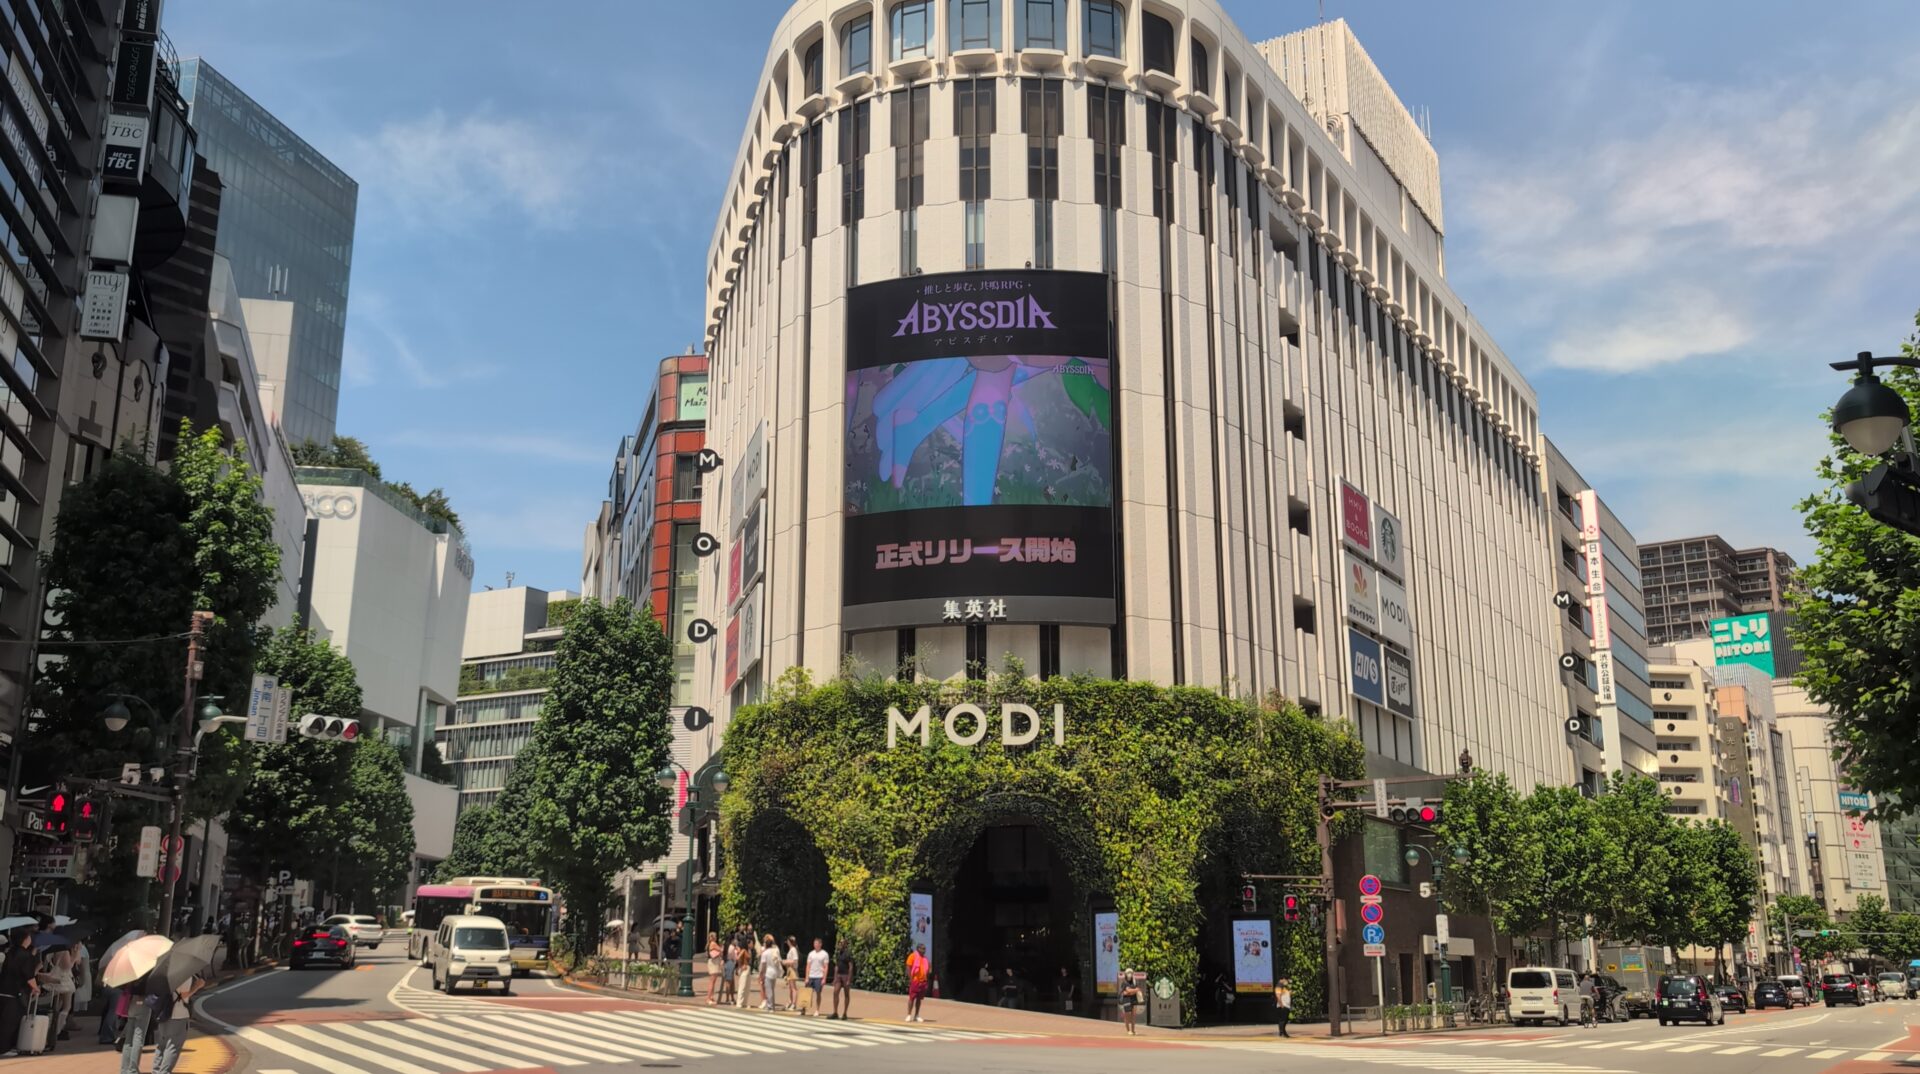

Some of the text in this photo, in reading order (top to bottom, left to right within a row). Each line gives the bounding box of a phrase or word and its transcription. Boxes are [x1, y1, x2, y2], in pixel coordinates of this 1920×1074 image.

[111, 125, 143, 139] TBC
[25, 149, 39, 183] TBC
[107, 156, 136, 170] TBC
[923, 279, 1023, 296] 推しと歩む、共鳴RPG
[890, 293, 1059, 338] ABYSSDIA
[933, 334, 1015, 346] アビスディア
[1052, 364, 1096, 376] ABYSSDIA
[1345, 519, 1369, 541] BOOKS
[875, 536, 1077, 570] 正式リリース開始
[1589, 543, 1602, 592] 日本生命
[942, 598, 1007, 620] 集英社
[1381, 599, 1407, 626] MODI
[1713, 617, 1768, 643] ニトリ
[1715, 640, 1771, 659] NITORI
[1354, 650, 1379, 685] HIS
[1390, 675, 1407, 696] Tiger
[250, 687, 261, 716] Jinnan
[887, 703, 1065, 748] MODI
[1840, 795, 1868, 807] NITORI
[279, 869, 292, 884] P
